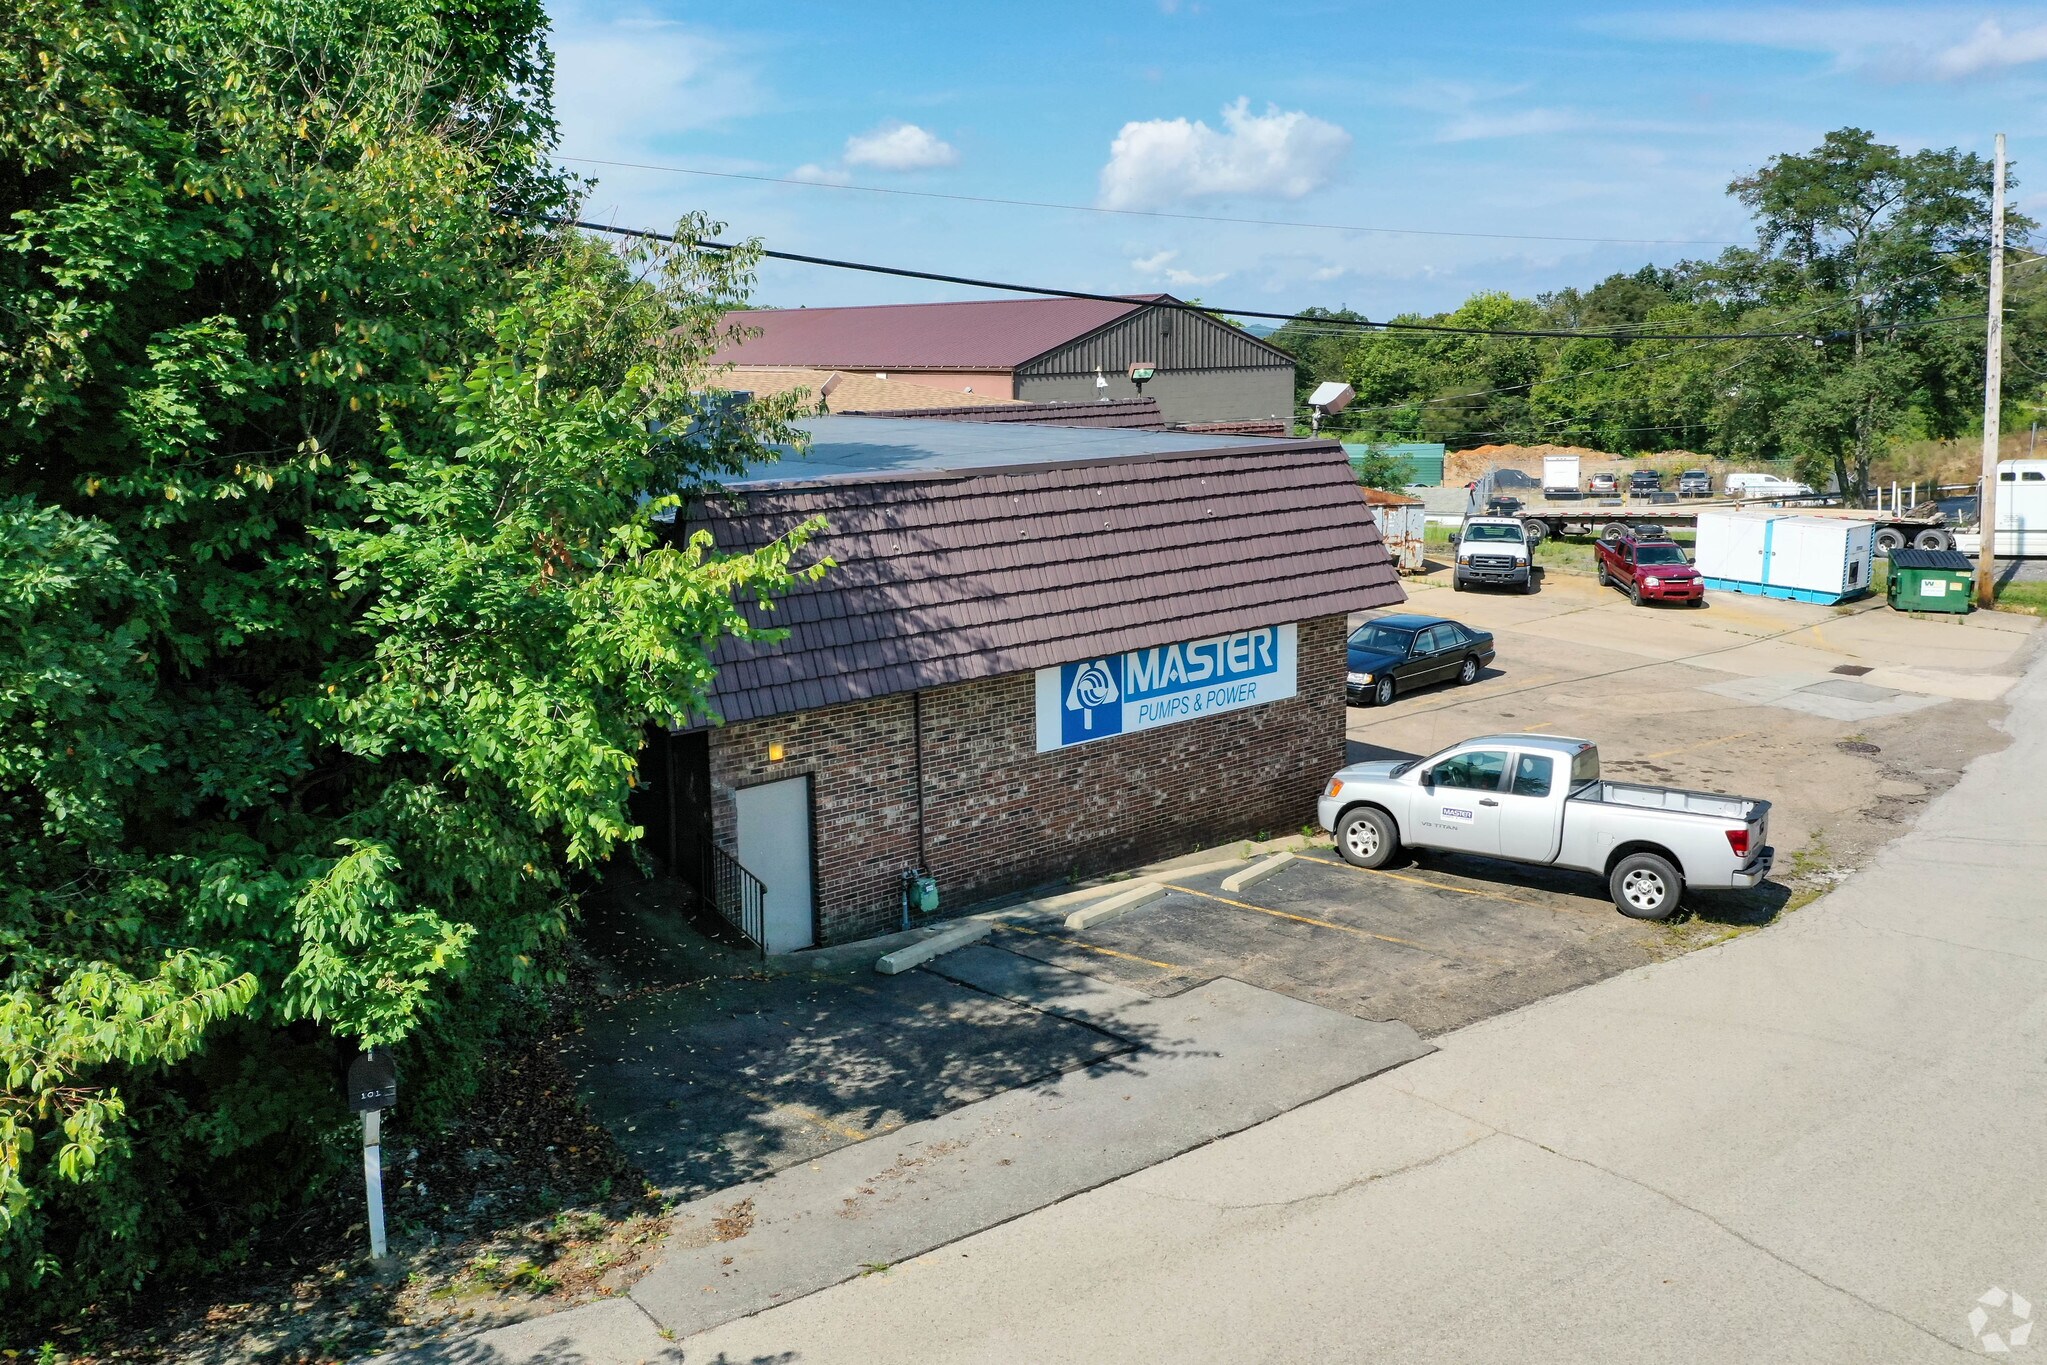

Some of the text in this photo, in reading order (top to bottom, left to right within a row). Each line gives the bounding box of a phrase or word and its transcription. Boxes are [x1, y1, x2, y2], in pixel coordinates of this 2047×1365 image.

[1127, 626, 1274, 695] MASTER
[1138, 681, 1257, 724] PUMPS & POWER
[1443, 809, 1472, 818] MASTER
[361, 1090, 381, 1100] 101
